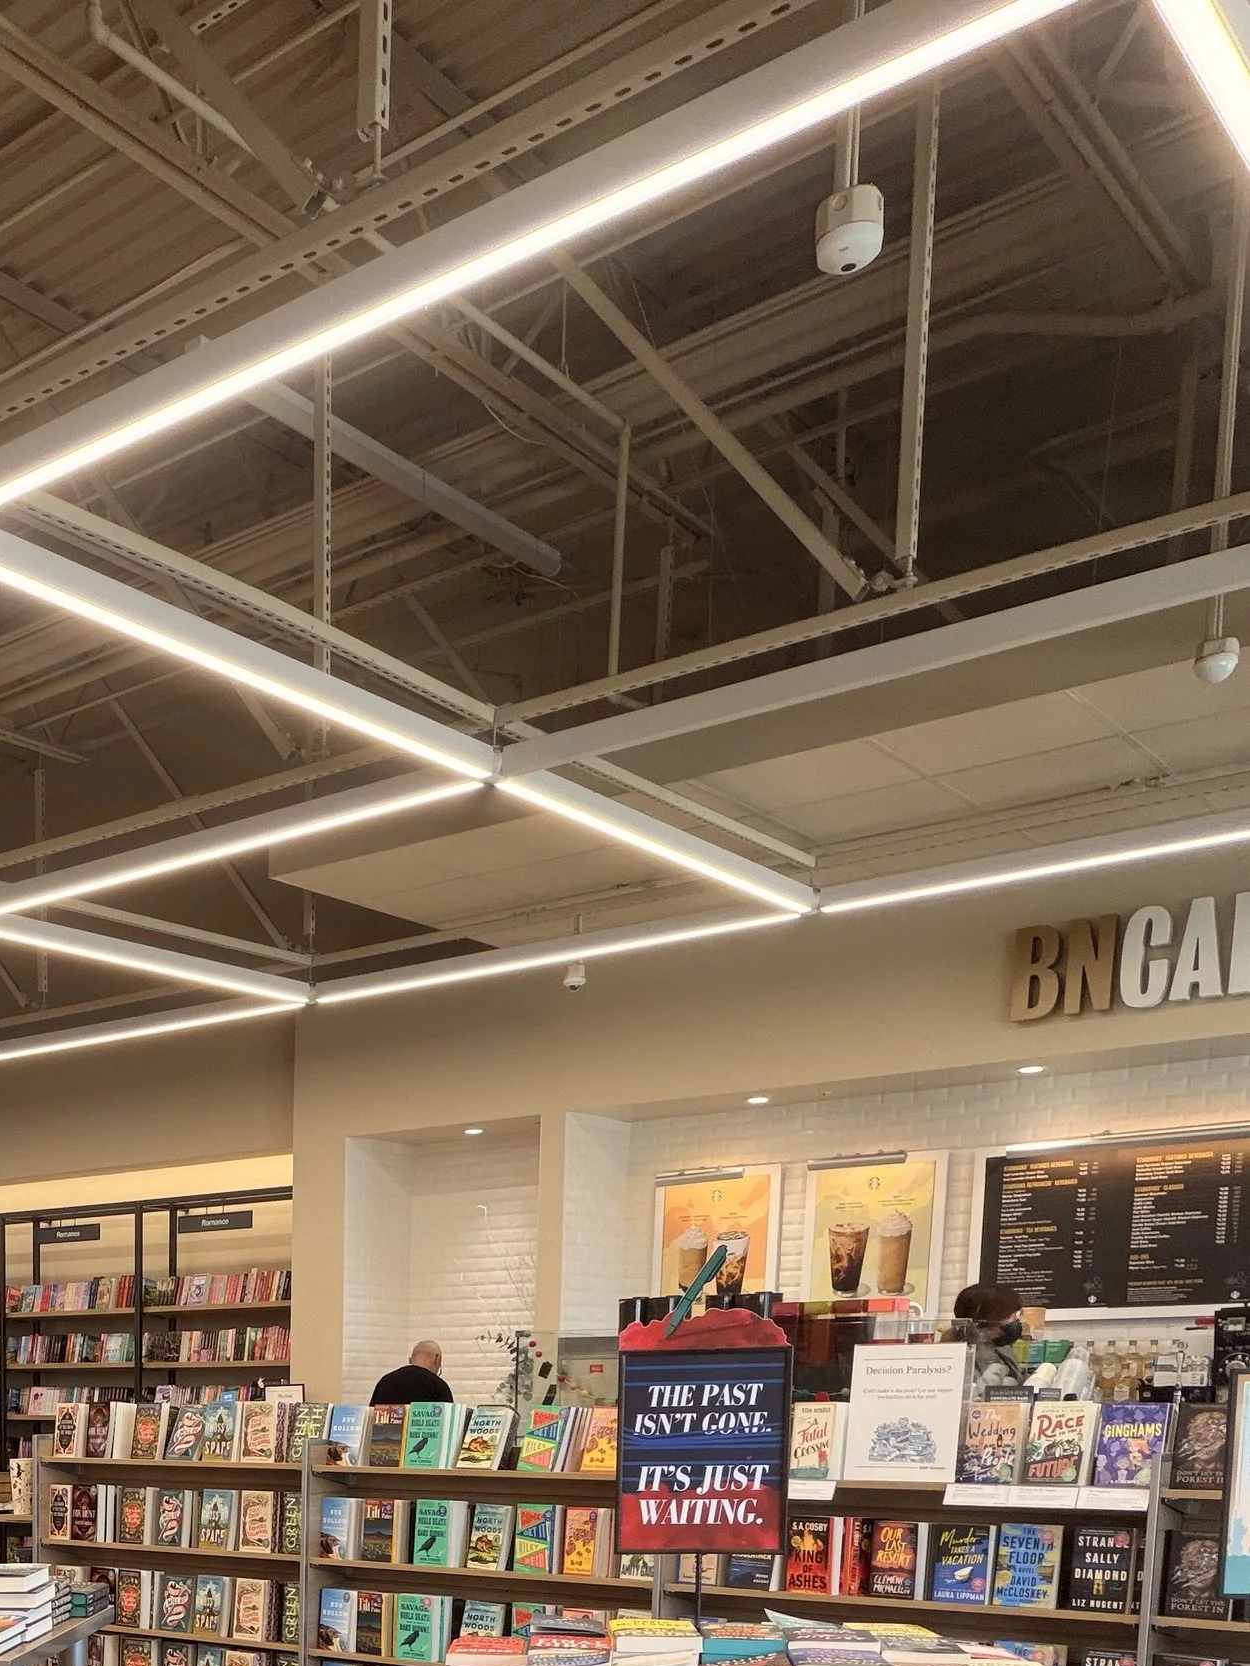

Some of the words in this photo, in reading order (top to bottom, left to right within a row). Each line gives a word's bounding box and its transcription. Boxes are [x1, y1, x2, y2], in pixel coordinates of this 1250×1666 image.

[202, 1218, 229, 1227] Romance
[56, 1230, 81, 1238] Romance
[865, 1366, 904, 1375] Decision
[906, 1365, 952, 1376] Paralysis?
[649, 1384, 696, 1407] THE
[700, 1383, 763, 1407] PAST
[374, 1411, 389, 1424] Tilt
[472, 1419, 501, 1427] NORTH
[633, 1413, 696, 1436] ISN'T
[702, 1412, 772, 1434] GONE.
[1037, 1414, 1085, 1441] RACE
[291, 1406, 309, 1458] GREEN
[797, 1422, 829, 1445] Fatal
[968, 1421, 1016, 1441] Wedding
[1104, 1423, 1162, 1438] GINGHAMS
[637, 1465, 692, 1492] IT'S
[696, 1464, 770, 1495] JUST
[1175, 1475, 1214, 1483] FOREST
[366, 1504, 380, 1519] Tilt
[639, 1498, 764, 1525] WAITING.
[286, 1497, 297, 1548] GREEN
[476, 1516, 502, 1525] NORTH
[475, 1526, 502, 1534] WOODS
[805, 1522, 828, 1532] COSBY
[1022, 1527, 1037, 1535] THE
[881, 1527, 904, 1543] OUR
[940, 1527, 981, 1548] Murder
[885, 1539, 907, 1552] LAST
[950, 1545, 969, 1554] TAKES
[794, 1550, 823, 1563] KING
[876, 1550, 912, 1566] RESORT
[941, 1554, 984, 1566] VACATION
[1009, 1552, 1045, 1564] FLOOR
[1085, 1553, 1120, 1564] SALLY
[621, 1565, 639, 1576] AMITY
[802, 1564, 813, 1573] OF
[788, 1574, 828, 1588] ASHES
[1075, 1568, 1127, 1582] DIAMOND
[1010, 1576, 1037, 1587] DAVID
[934, 1590, 954, 1599] LAURA
[956, 1591, 985, 1600] LIPPMAN
[996, 1586, 1048, 1599] McCLOSKEY
[359, 1598, 370, 1612] Tilt
[1072, 1598, 1086, 1606] LIZ
[1090, 1600, 1124, 1610] NUGENT
[1170, 1603, 1210, 1612] FOREST
[286, 1587, 297, 1638] GREEN
[466, 1612, 496, 1622] NORTH
[464, 1622, 495, 1632] WOODS
[1014, 1647, 1027, 1657] THE
